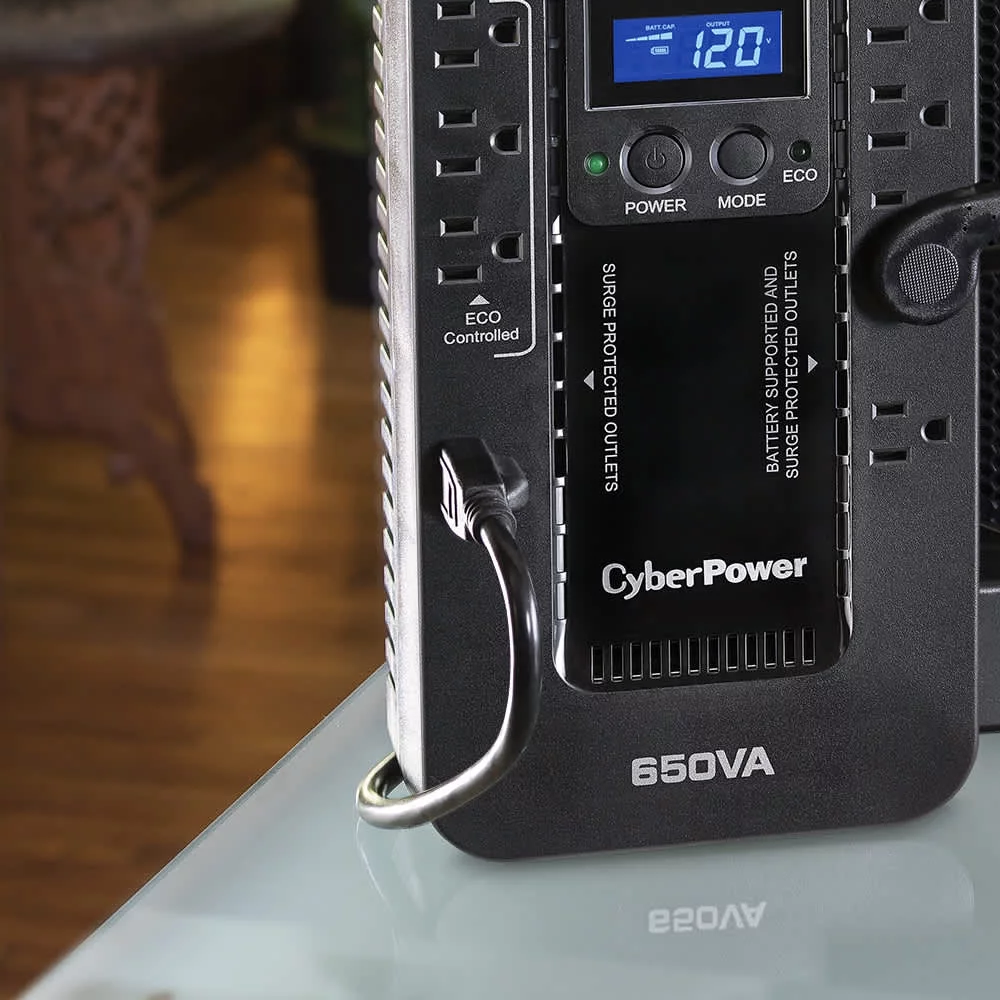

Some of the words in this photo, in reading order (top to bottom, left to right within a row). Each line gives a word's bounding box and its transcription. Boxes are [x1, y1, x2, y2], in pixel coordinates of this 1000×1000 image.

[705, 20, 730, 28] OUTPUT
[692, 26, 764, 69] 120
[783, 168, 818, 183] ECO
[625, 198, 687, 215] POWER
[717, 193, 767, 209] MODE
[602, 263, 617, 319] SURGE
[764, 265, 778, 299] AND
[783, 250, 798, 322] OUTLETS
[443, 327, 520, 345] Controlled
[465, 310, 502, 326] ECO
[603, 322, 618, 418] PROTECTED
[764, 302, 779, 398] SUPPORTED
[784, 325, 799, 421] PROTECTED
[603, 421, 619, 492] OUTLETS
[765, 402, 780, 473] BATTERY
[785, 423, 799, 479] SURGE
[601, 556, 808, 601] CyberPower
[631, 746, 775, 787] 650VA
